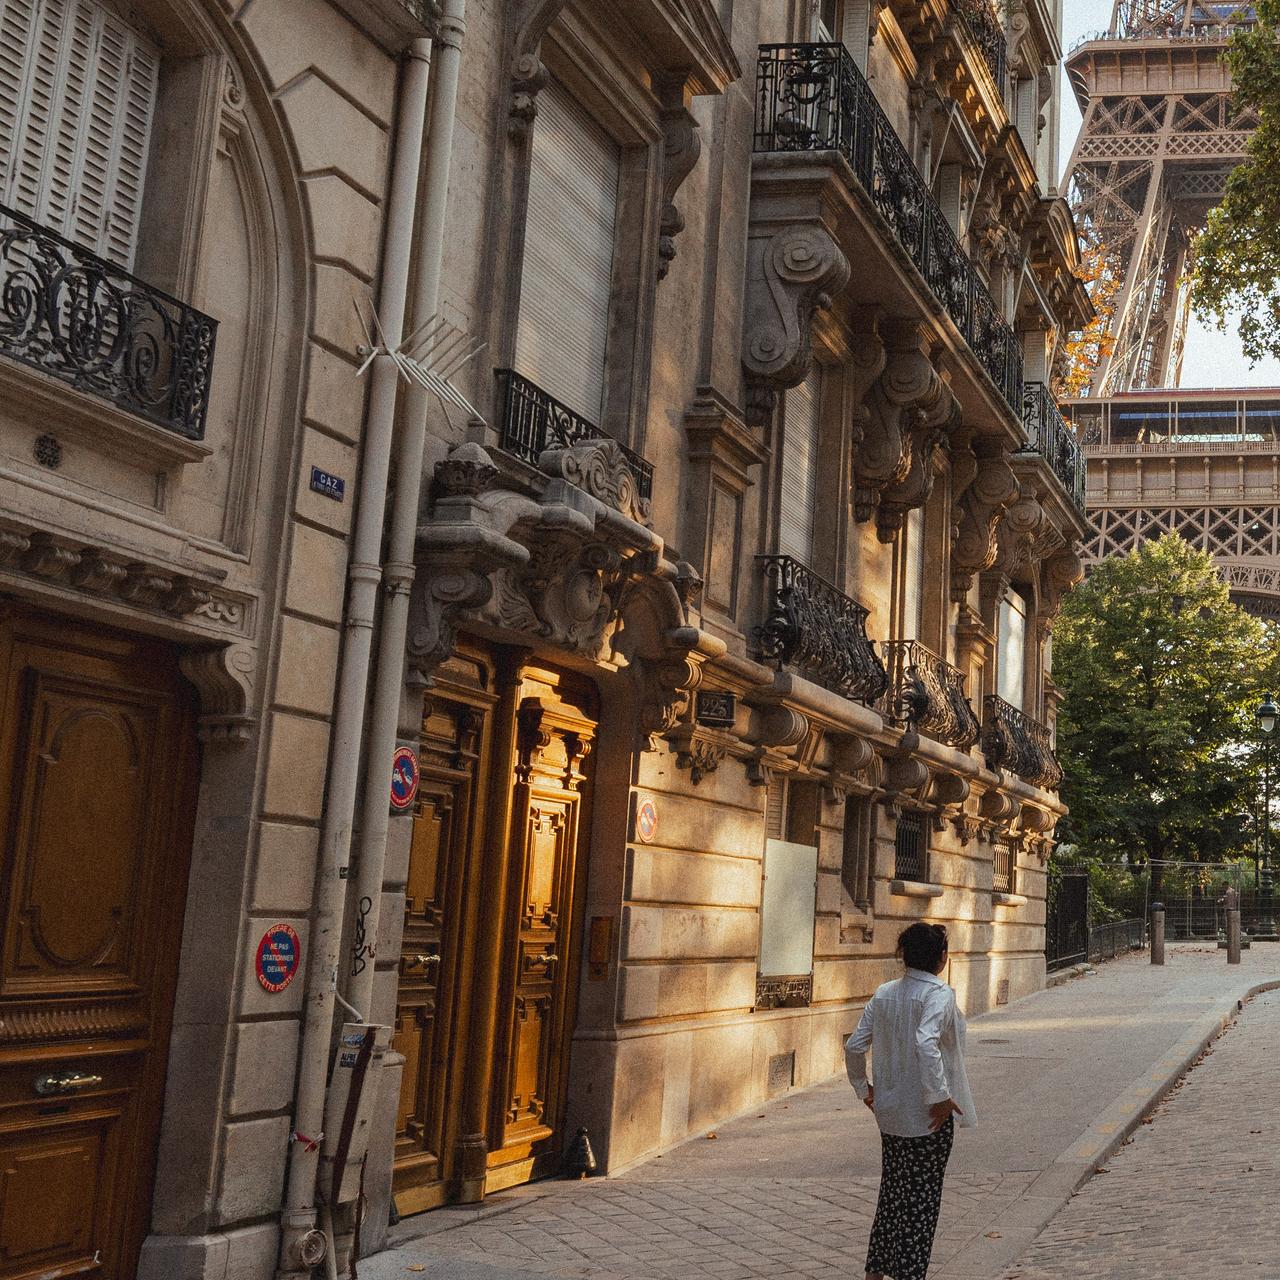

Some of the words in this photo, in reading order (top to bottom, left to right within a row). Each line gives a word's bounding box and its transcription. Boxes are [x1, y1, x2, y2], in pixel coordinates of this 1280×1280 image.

[320, 473, 338, 489] GAZ
[270, 942, 278, 950] NE
[278, 942, 289, 951] PAS
[266, 965, 287, 973] DEVANT
[260, 974, 276, 991] CETTE
